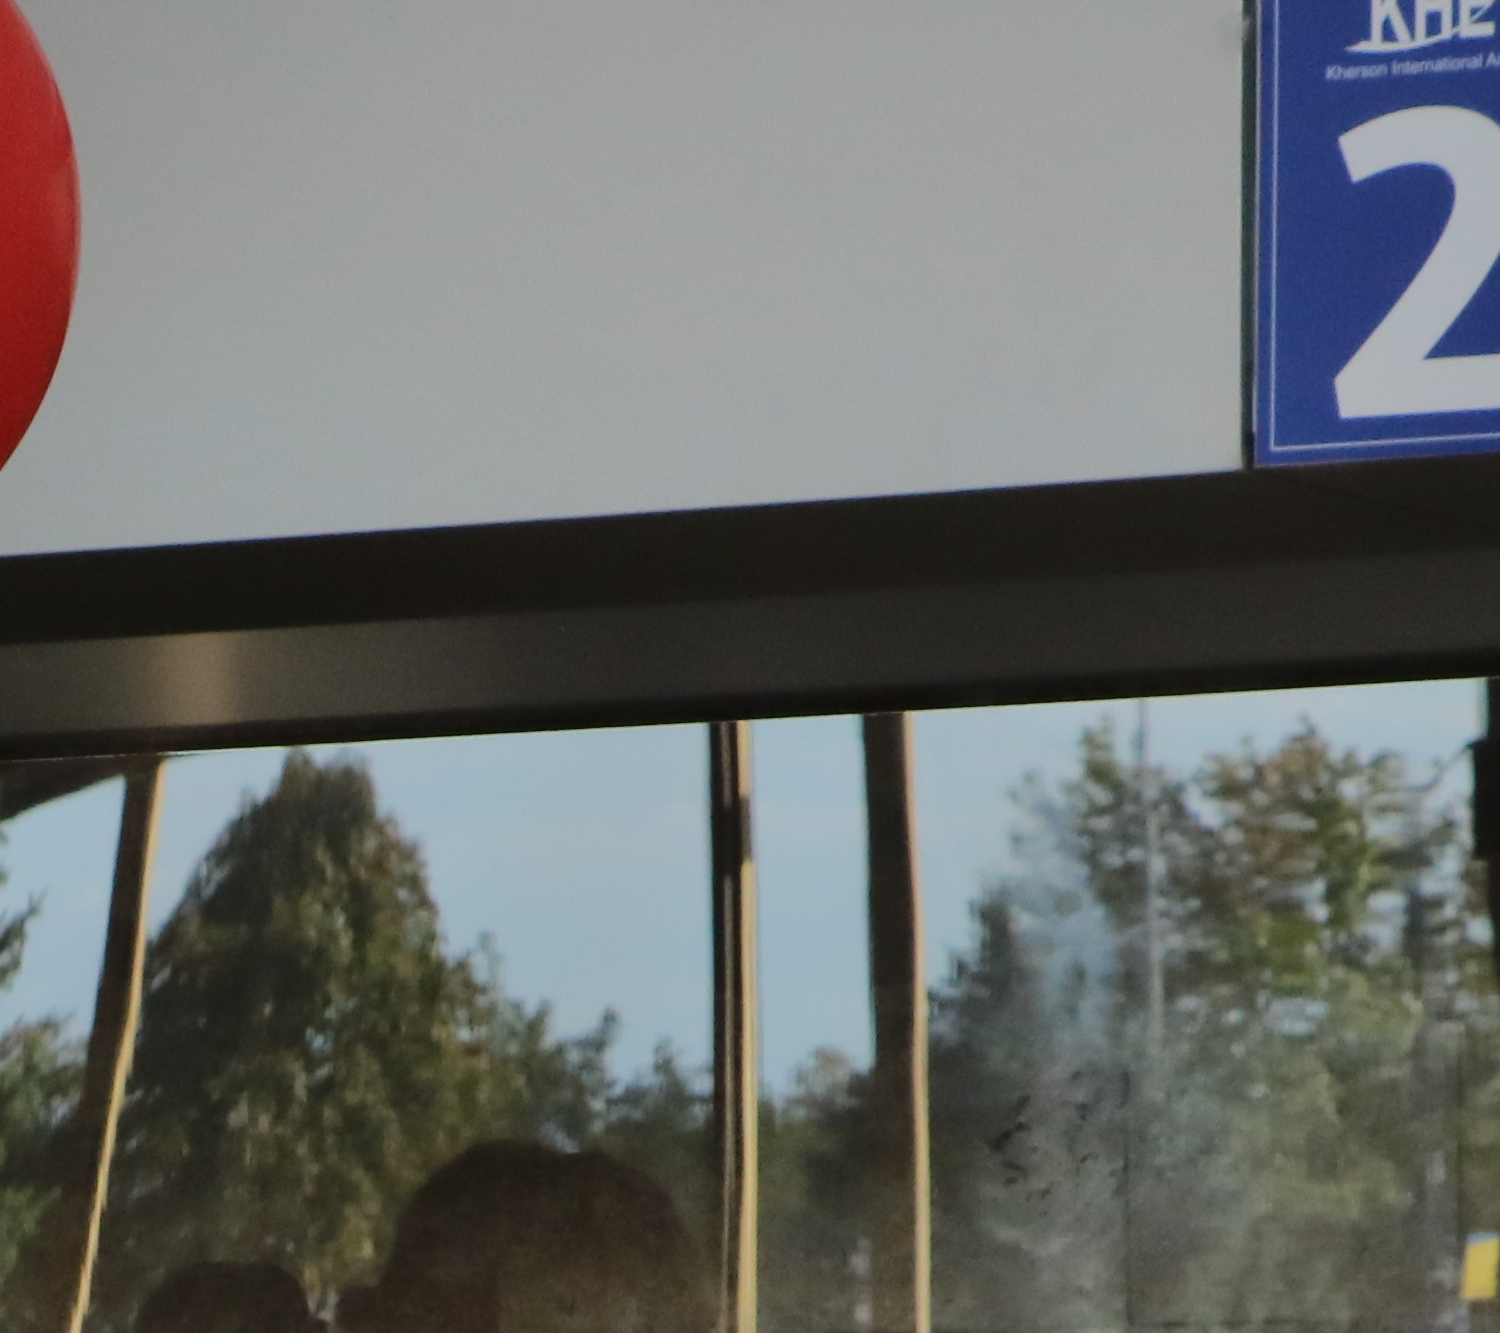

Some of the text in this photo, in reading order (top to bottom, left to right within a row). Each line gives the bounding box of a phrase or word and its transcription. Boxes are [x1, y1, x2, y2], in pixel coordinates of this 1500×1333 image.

[1370, 0, 1497, 45] KHE
[1325, 60, 1388, 82] Kherson
[1391, 55, 1484, 77] International
